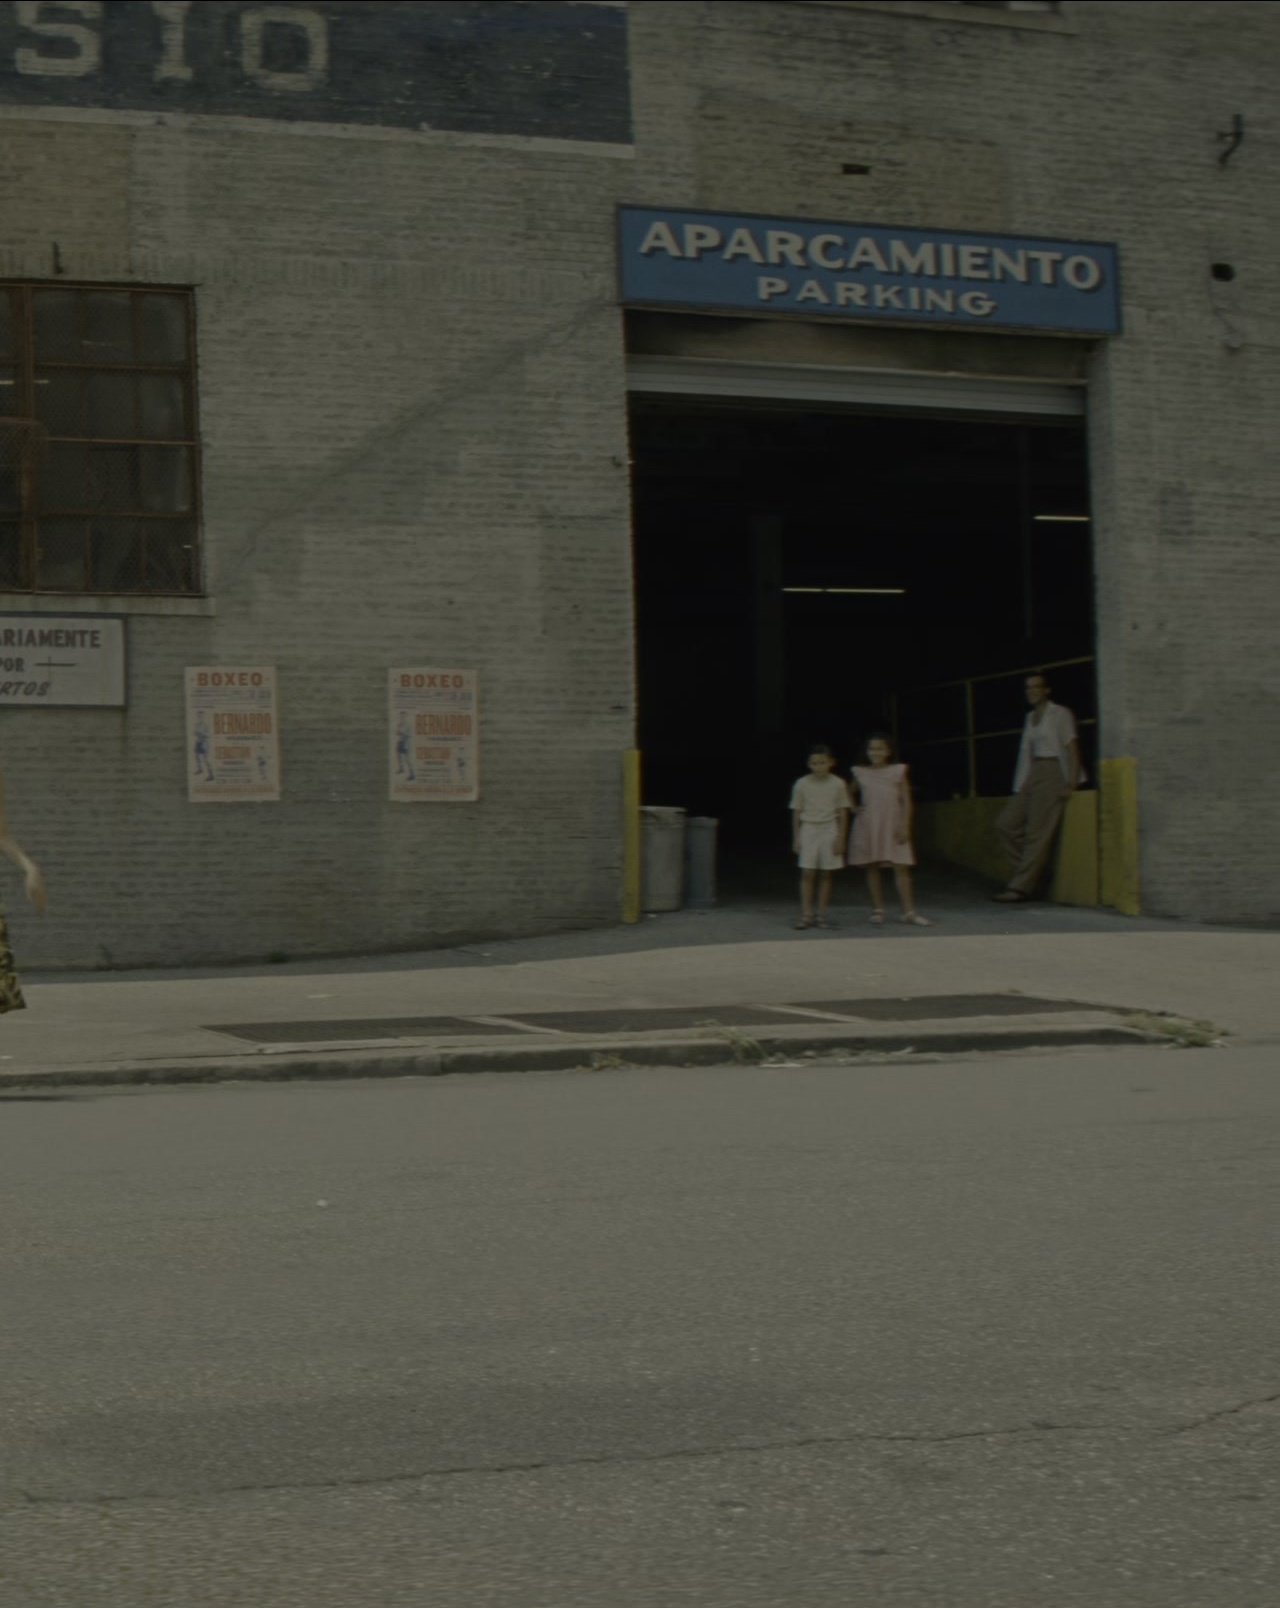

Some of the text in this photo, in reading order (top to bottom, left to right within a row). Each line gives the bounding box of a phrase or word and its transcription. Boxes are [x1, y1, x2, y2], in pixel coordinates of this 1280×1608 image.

[639, 221, 1101, 292] APARCAMIENTO
[758, 276, 995, 317] PARKING
[198, 673, 263, 686] BOXEO
[400, 674, 464, 688] BOXEO
[214, 713, 272, 735] BERNARDO
[416, 714, 472, 735] BERNARDO
